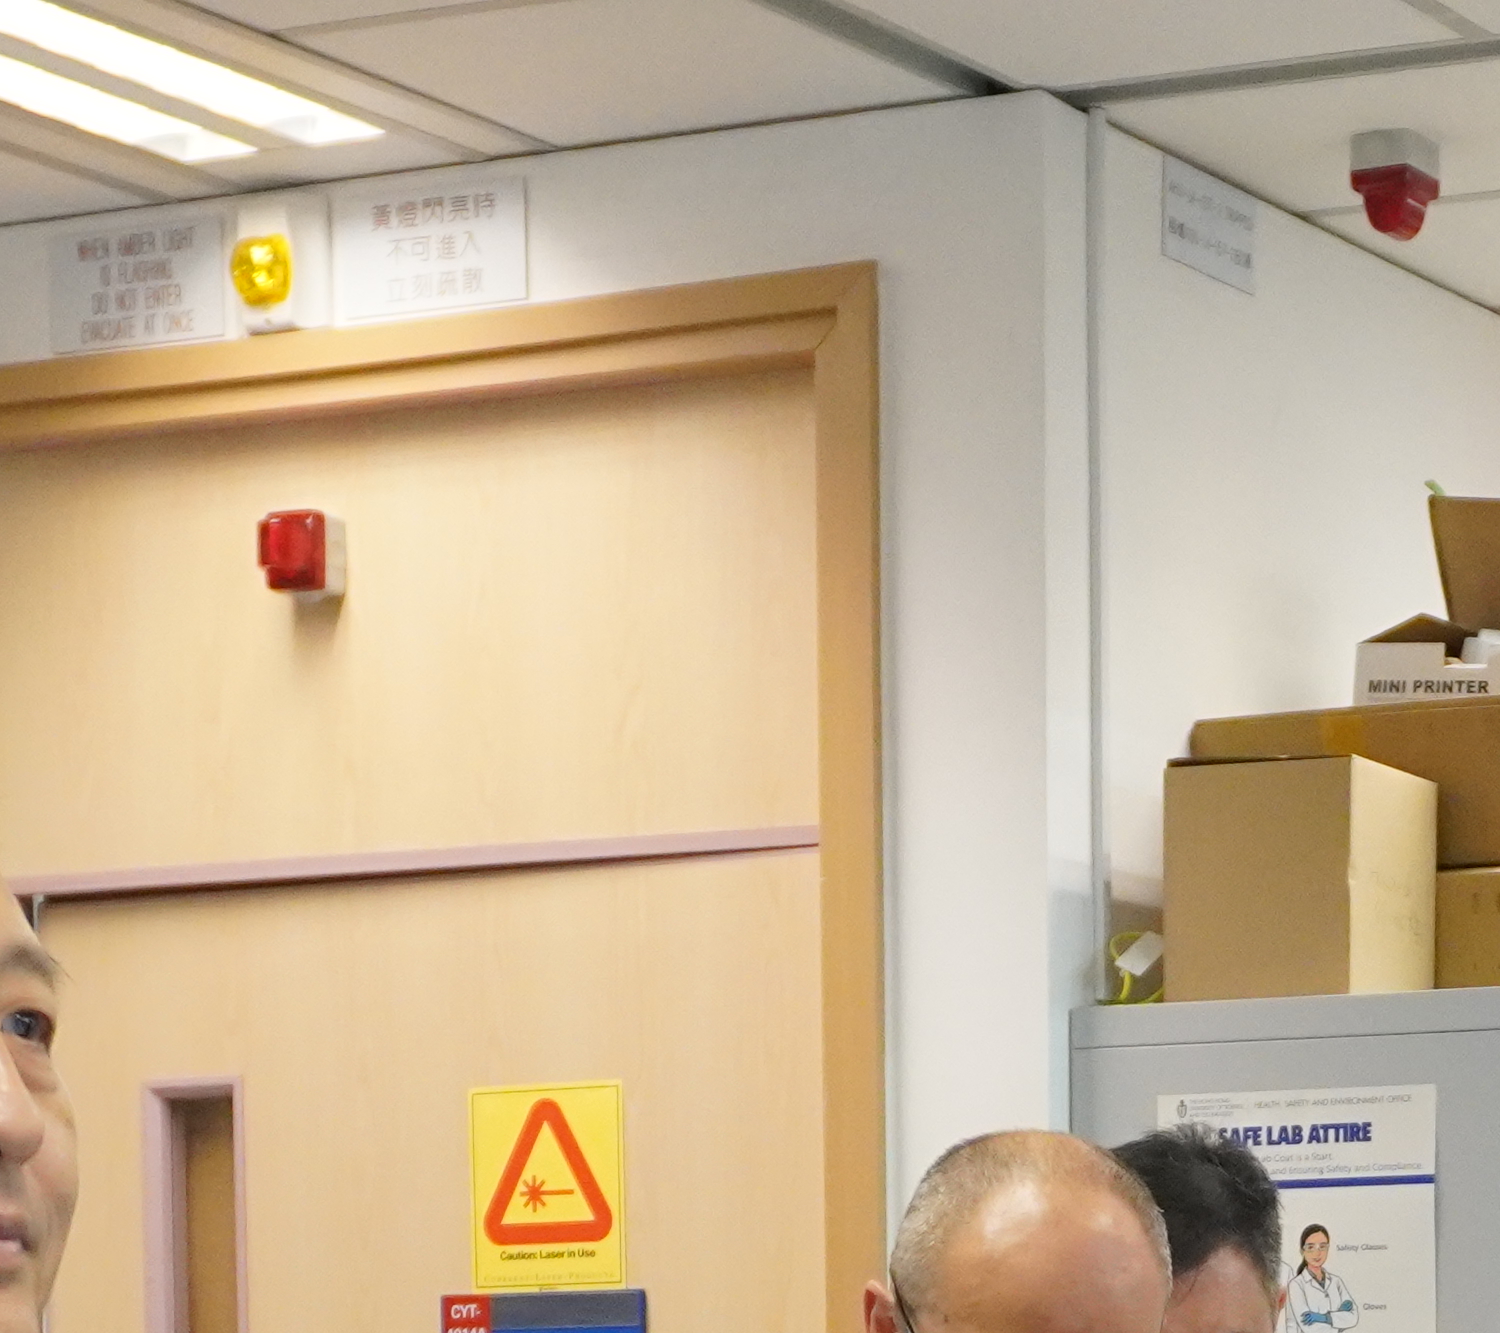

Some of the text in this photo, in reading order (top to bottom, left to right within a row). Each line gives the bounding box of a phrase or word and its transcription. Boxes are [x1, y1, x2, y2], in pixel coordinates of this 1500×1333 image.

[1368, 679, 1490, 694] MINI PRINTER
[1266, 1124, 1304, 1146] LAB
[1307, 1122, 1373, 1144] ATTIRE
[539, 1249, 565, 1260] Laser
[567, 1248, 576, 1258] in
[578, 1248, 596, 1258] Use
